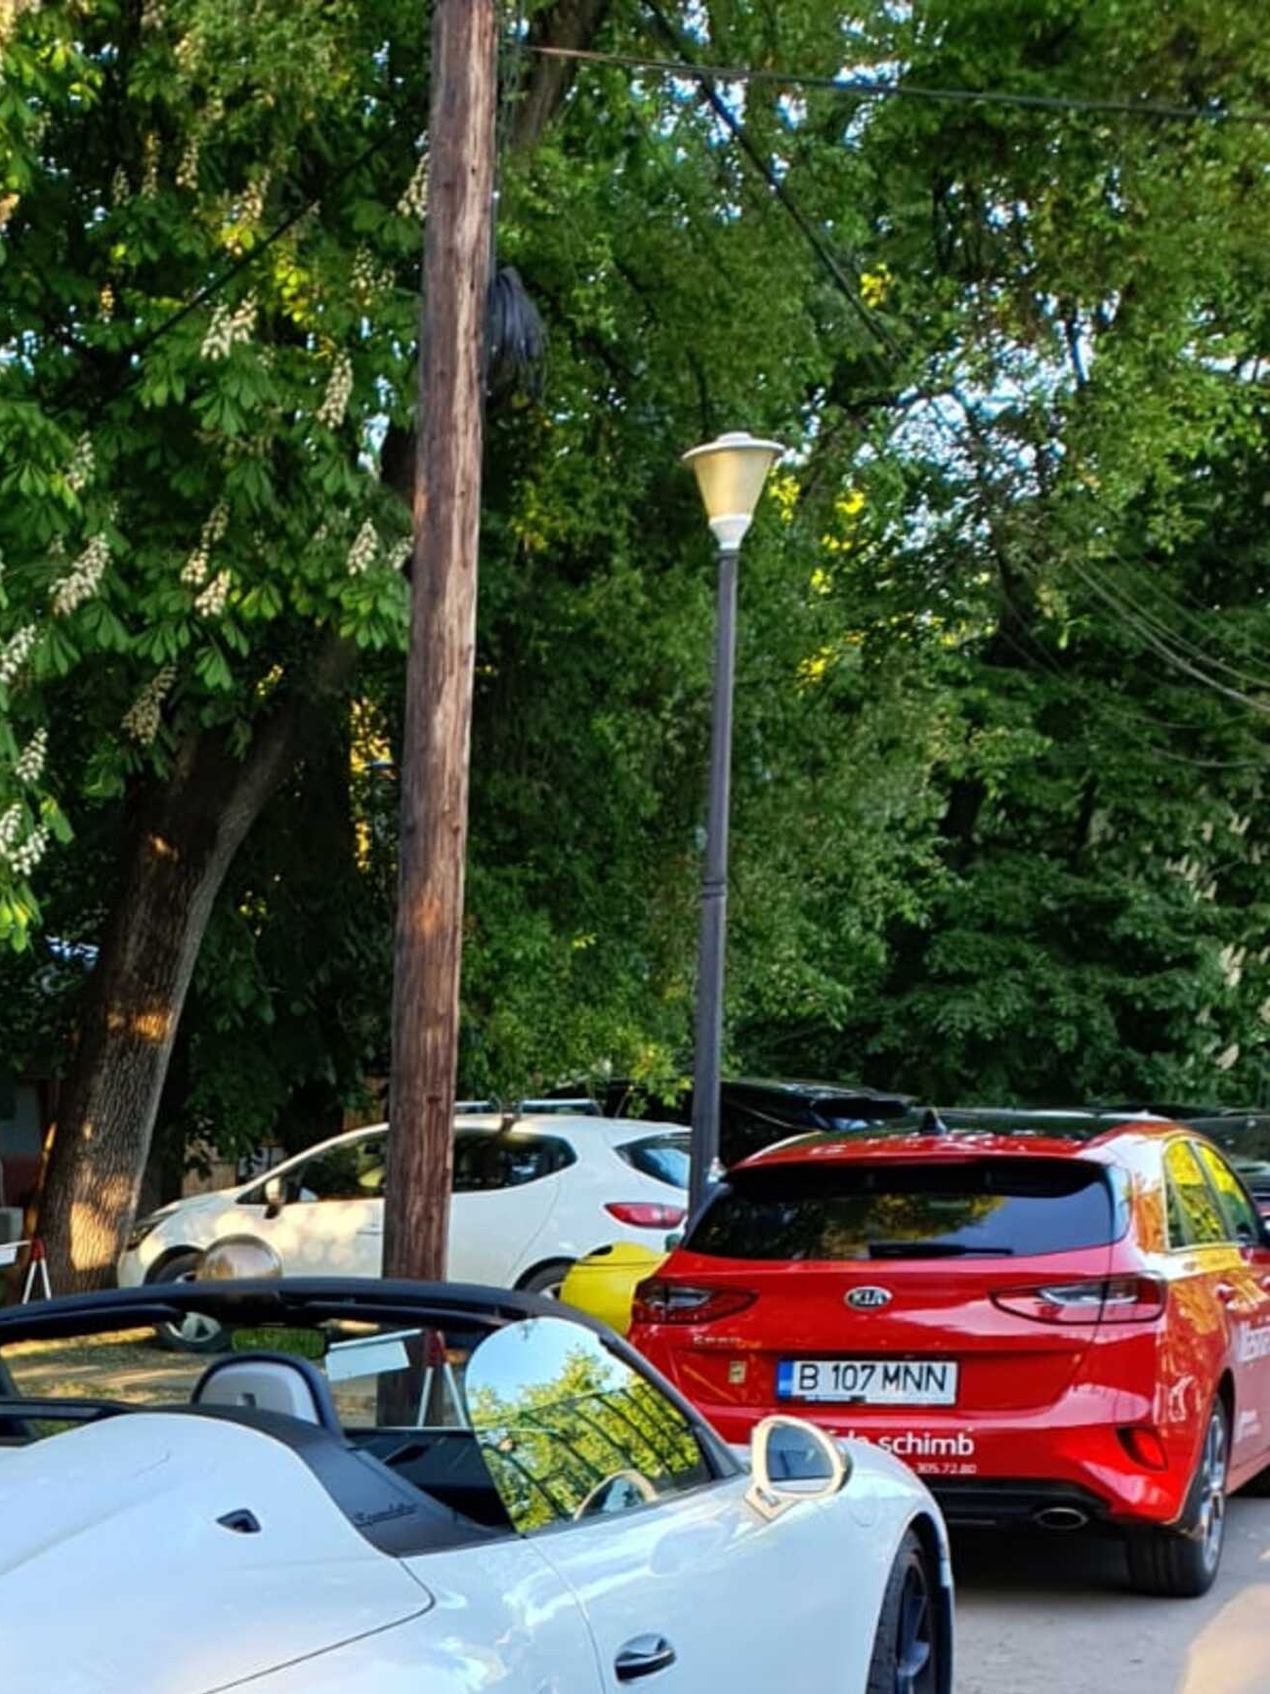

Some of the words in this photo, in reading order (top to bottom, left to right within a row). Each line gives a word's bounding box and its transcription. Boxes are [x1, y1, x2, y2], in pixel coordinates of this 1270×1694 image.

[847, 1288, 888, 1307] KIA
[799, 1364, 819, 1391] B
[831, 1364, 877, 1391] 107
[882, 1365, 950, 1393] MNN
[879, 1431, 975, 1456] schimb
